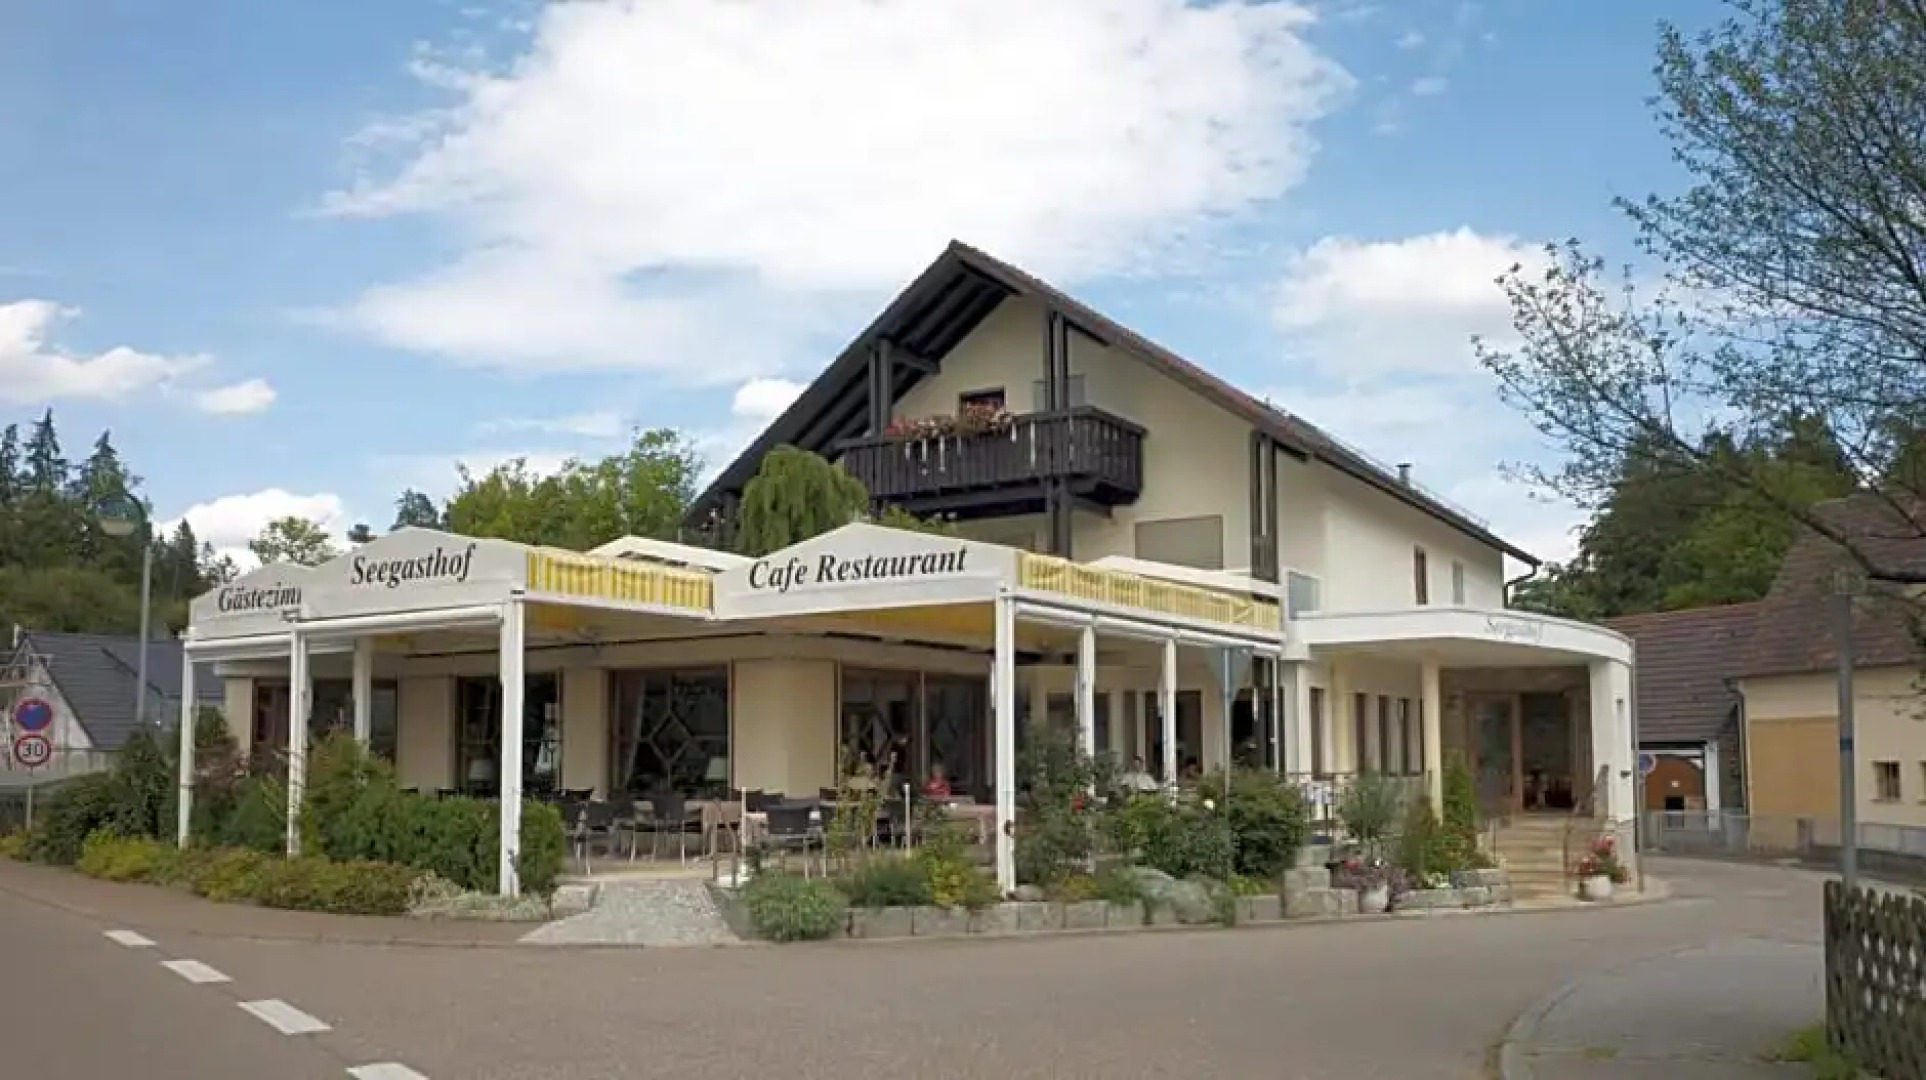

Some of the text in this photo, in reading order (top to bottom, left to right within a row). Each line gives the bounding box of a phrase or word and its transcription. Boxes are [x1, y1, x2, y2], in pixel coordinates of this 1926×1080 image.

[351, 544, 475, 588] Seegasthof
[749, 546, 967, 593] Cafe Restaurant
[22, 742, 44, 757] 30
